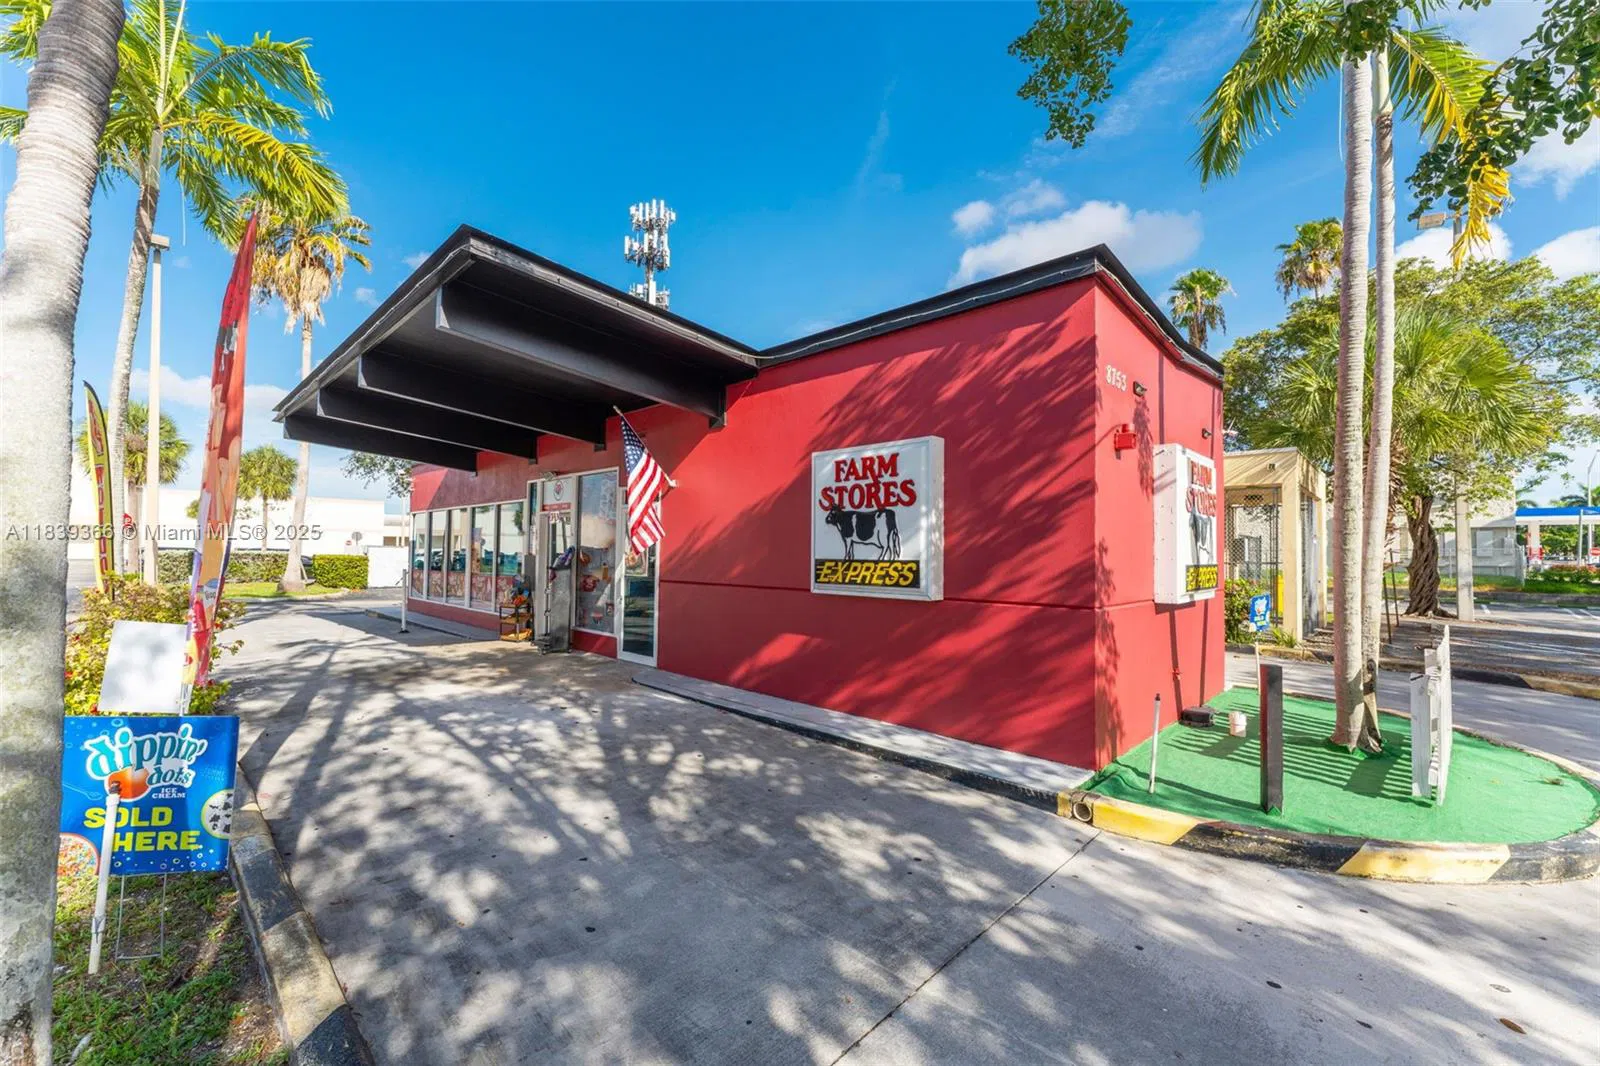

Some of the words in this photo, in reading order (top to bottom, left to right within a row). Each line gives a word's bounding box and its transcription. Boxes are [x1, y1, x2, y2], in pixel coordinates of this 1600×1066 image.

[1106, 364, 1127, 391] 8753
[834, 453, 899, 483] FARM
[819, 479, 917, 512] STORES
[817, 561, 917, 585] EXPRESS
[147, 765, 193, 786] dots
[84, 806, 173, 828] SOLD
[113, 831, 201, 852] HERE
